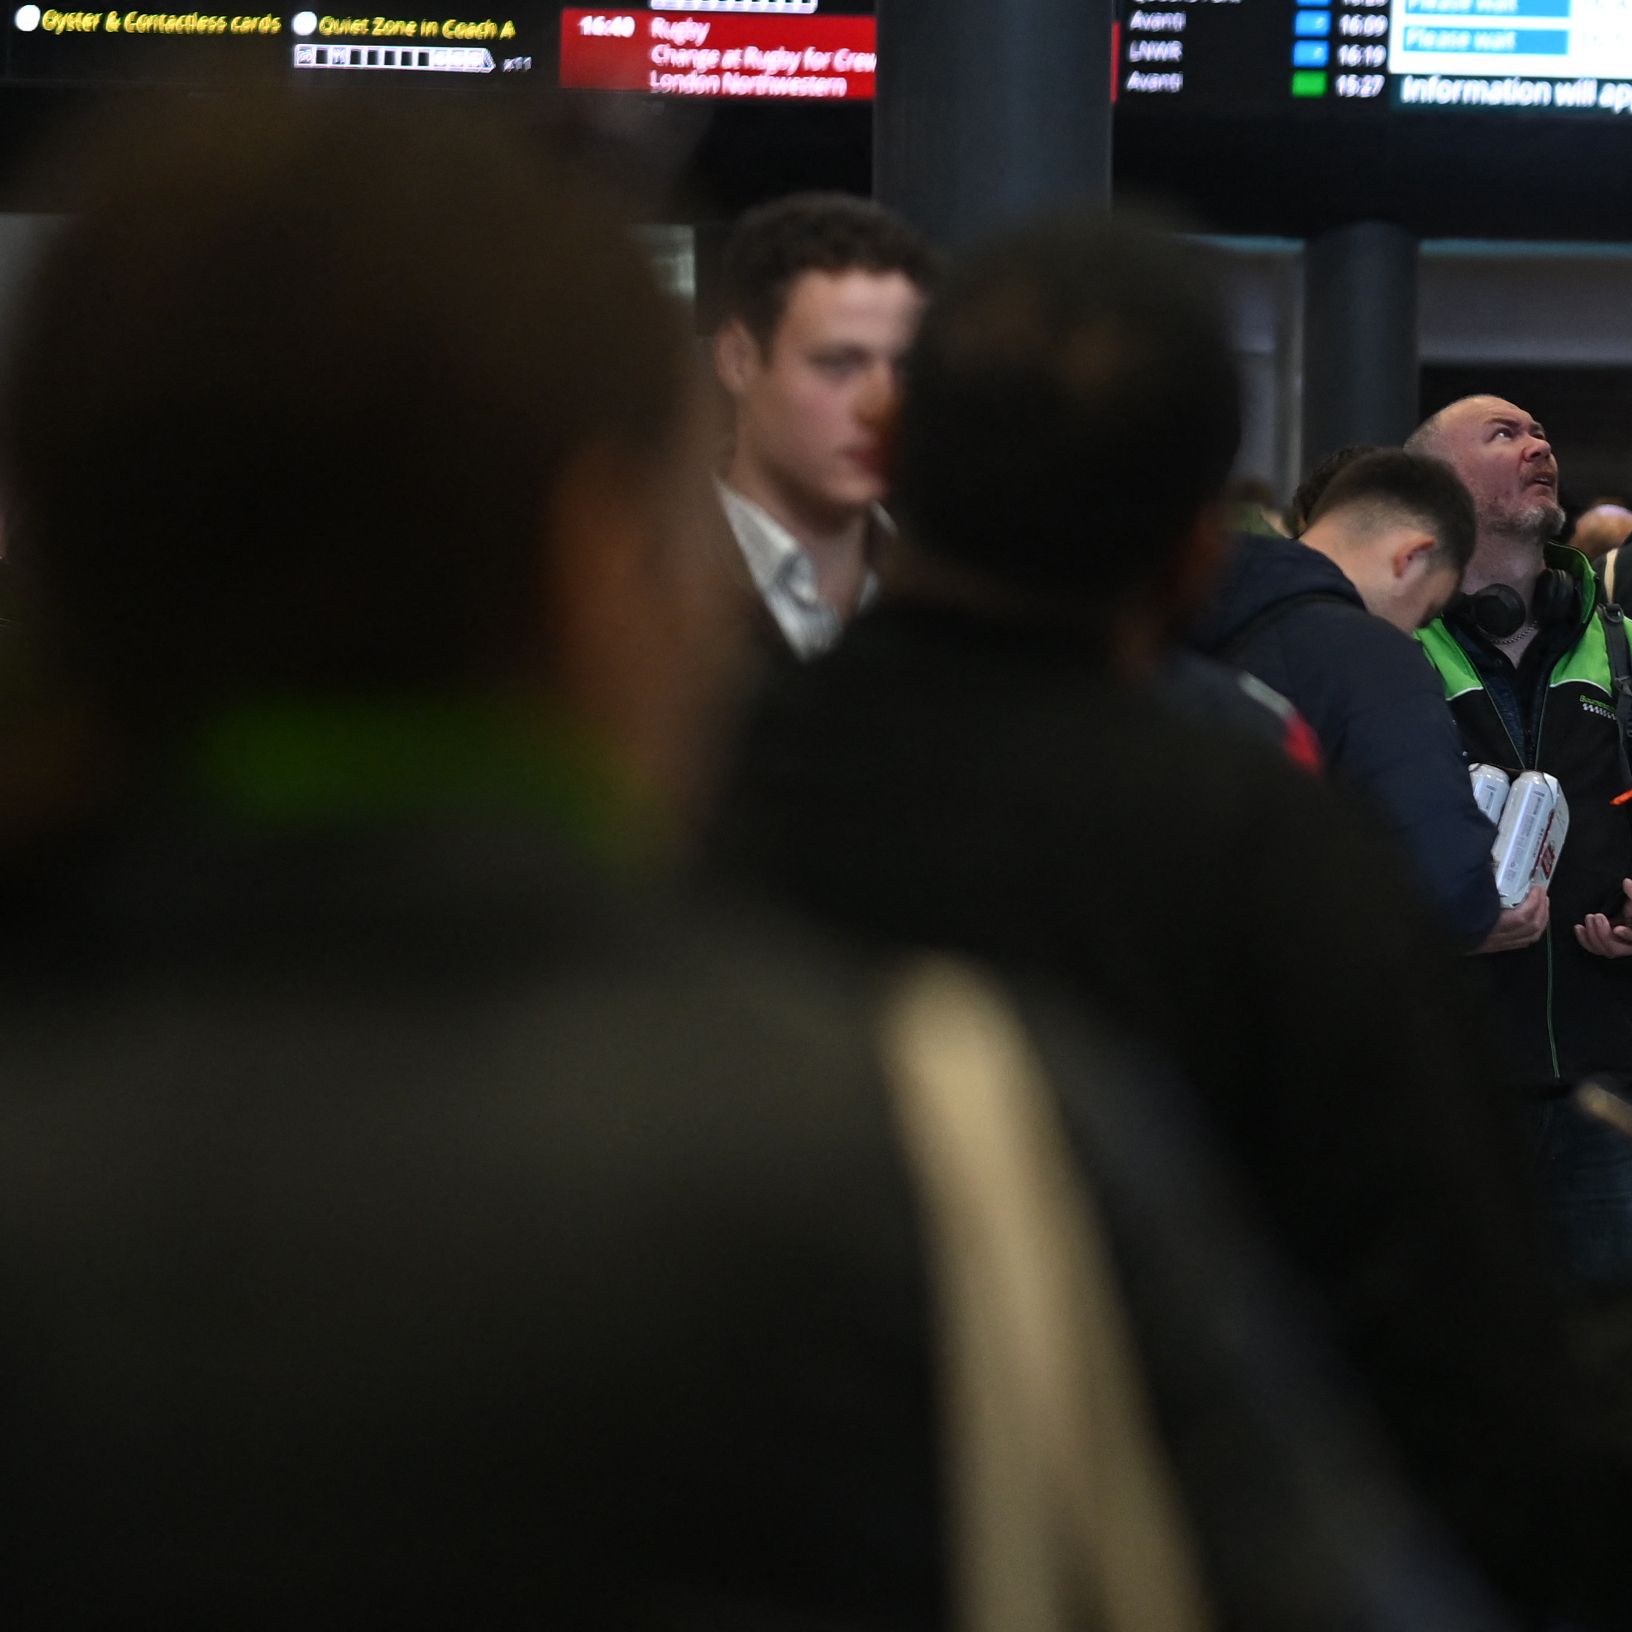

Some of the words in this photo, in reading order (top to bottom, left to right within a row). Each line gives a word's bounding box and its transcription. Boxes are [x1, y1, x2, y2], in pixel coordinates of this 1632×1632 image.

[650, 16, 711, 46] Rugby
[1400, 76, 1551, 107] Information
[1554, 78, 1596, 109] will
